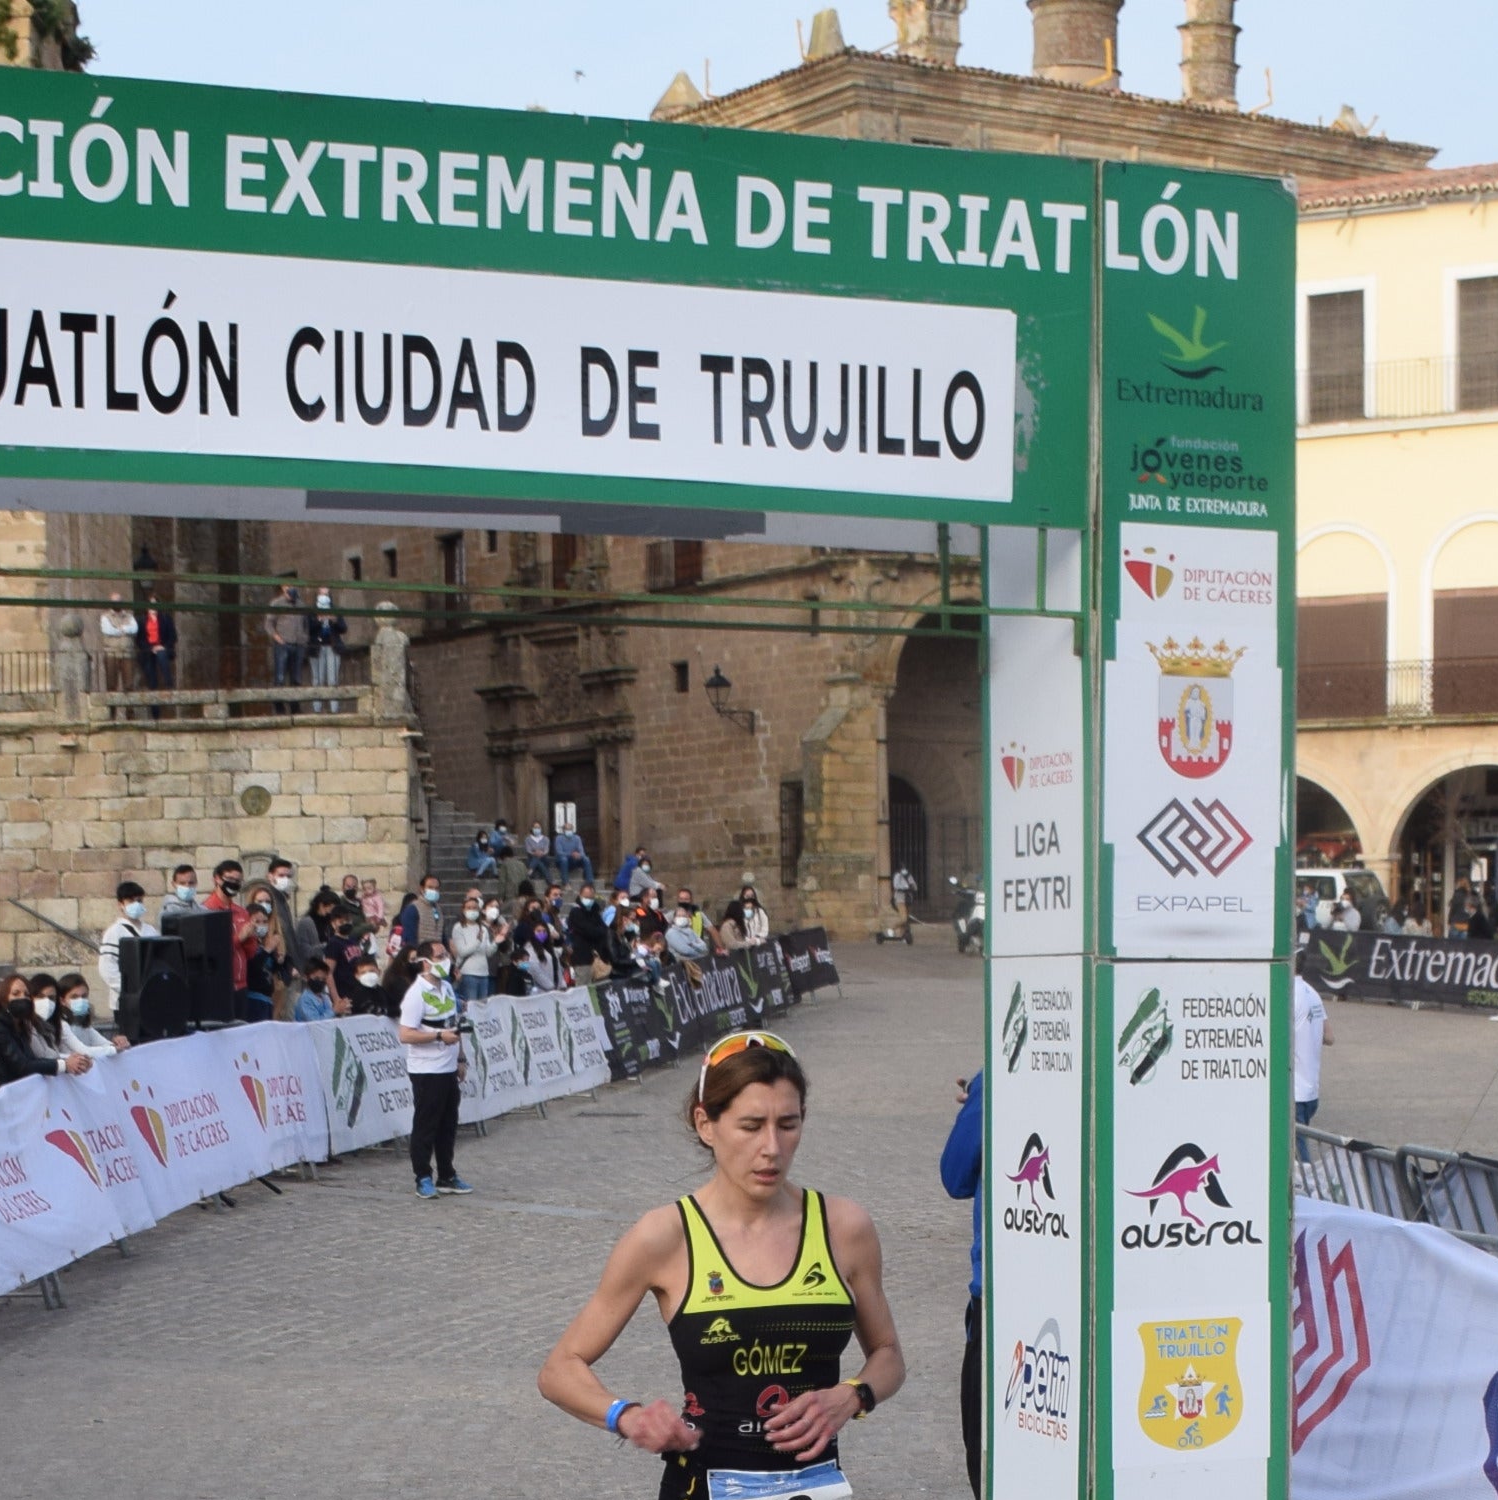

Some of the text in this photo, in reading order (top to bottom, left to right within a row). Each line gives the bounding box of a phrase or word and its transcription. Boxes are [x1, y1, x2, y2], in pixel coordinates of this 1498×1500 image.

[224, 133, 709, 246] EXTREMEÑA
[735, 175, 833, 255] DE
[857, 181, 1239, 281] TRIATLÓN
[285, 325, 537, 433] CIUDAD
[580, 345, 661, 441] DE
[700, 353, 987, 462] TRUJILLO
[1116, 377, 1264, 412] Extremadura
[1130, 437, 1243, 473] jóvenes
[1170, 435, 1239, 451] fundación
[1128, 493, 1269, 517] JUNTA DE EXTREMADURA
[1184, 566, 1273, 586] DIPUTACIÓN
[1184, 583, 1273, 606] DE CÁCERES
[1014, 820, 1061, 859] LIGA
[1003, 875, 1072, 913] FEXTRI
[1136, 895, 1253, 913] EXPAPEL
[1183, 992, 1267, 1018] FEDERACIÓN
[1185, 1023, 1264, 1050] EXTREMEÑA
[1181, 1059, 1199, 1081] DE
[163, 1089, 220, 1128] DIPUTACIÓN
[174, 1134, 189, 1158] DE
[1003, 1206, 1070, 1240] austral
[1120, 1219, 1263, 1250] austral
[1154, 1322, 1229, 1343] TRIATLÓN
[733, 1338, 808, 1376] GÓMEZ
[1157, 1341, 1226, 1359] TRUJILLO
[1018, 1411, 1068, 1441] BICICLETAS
